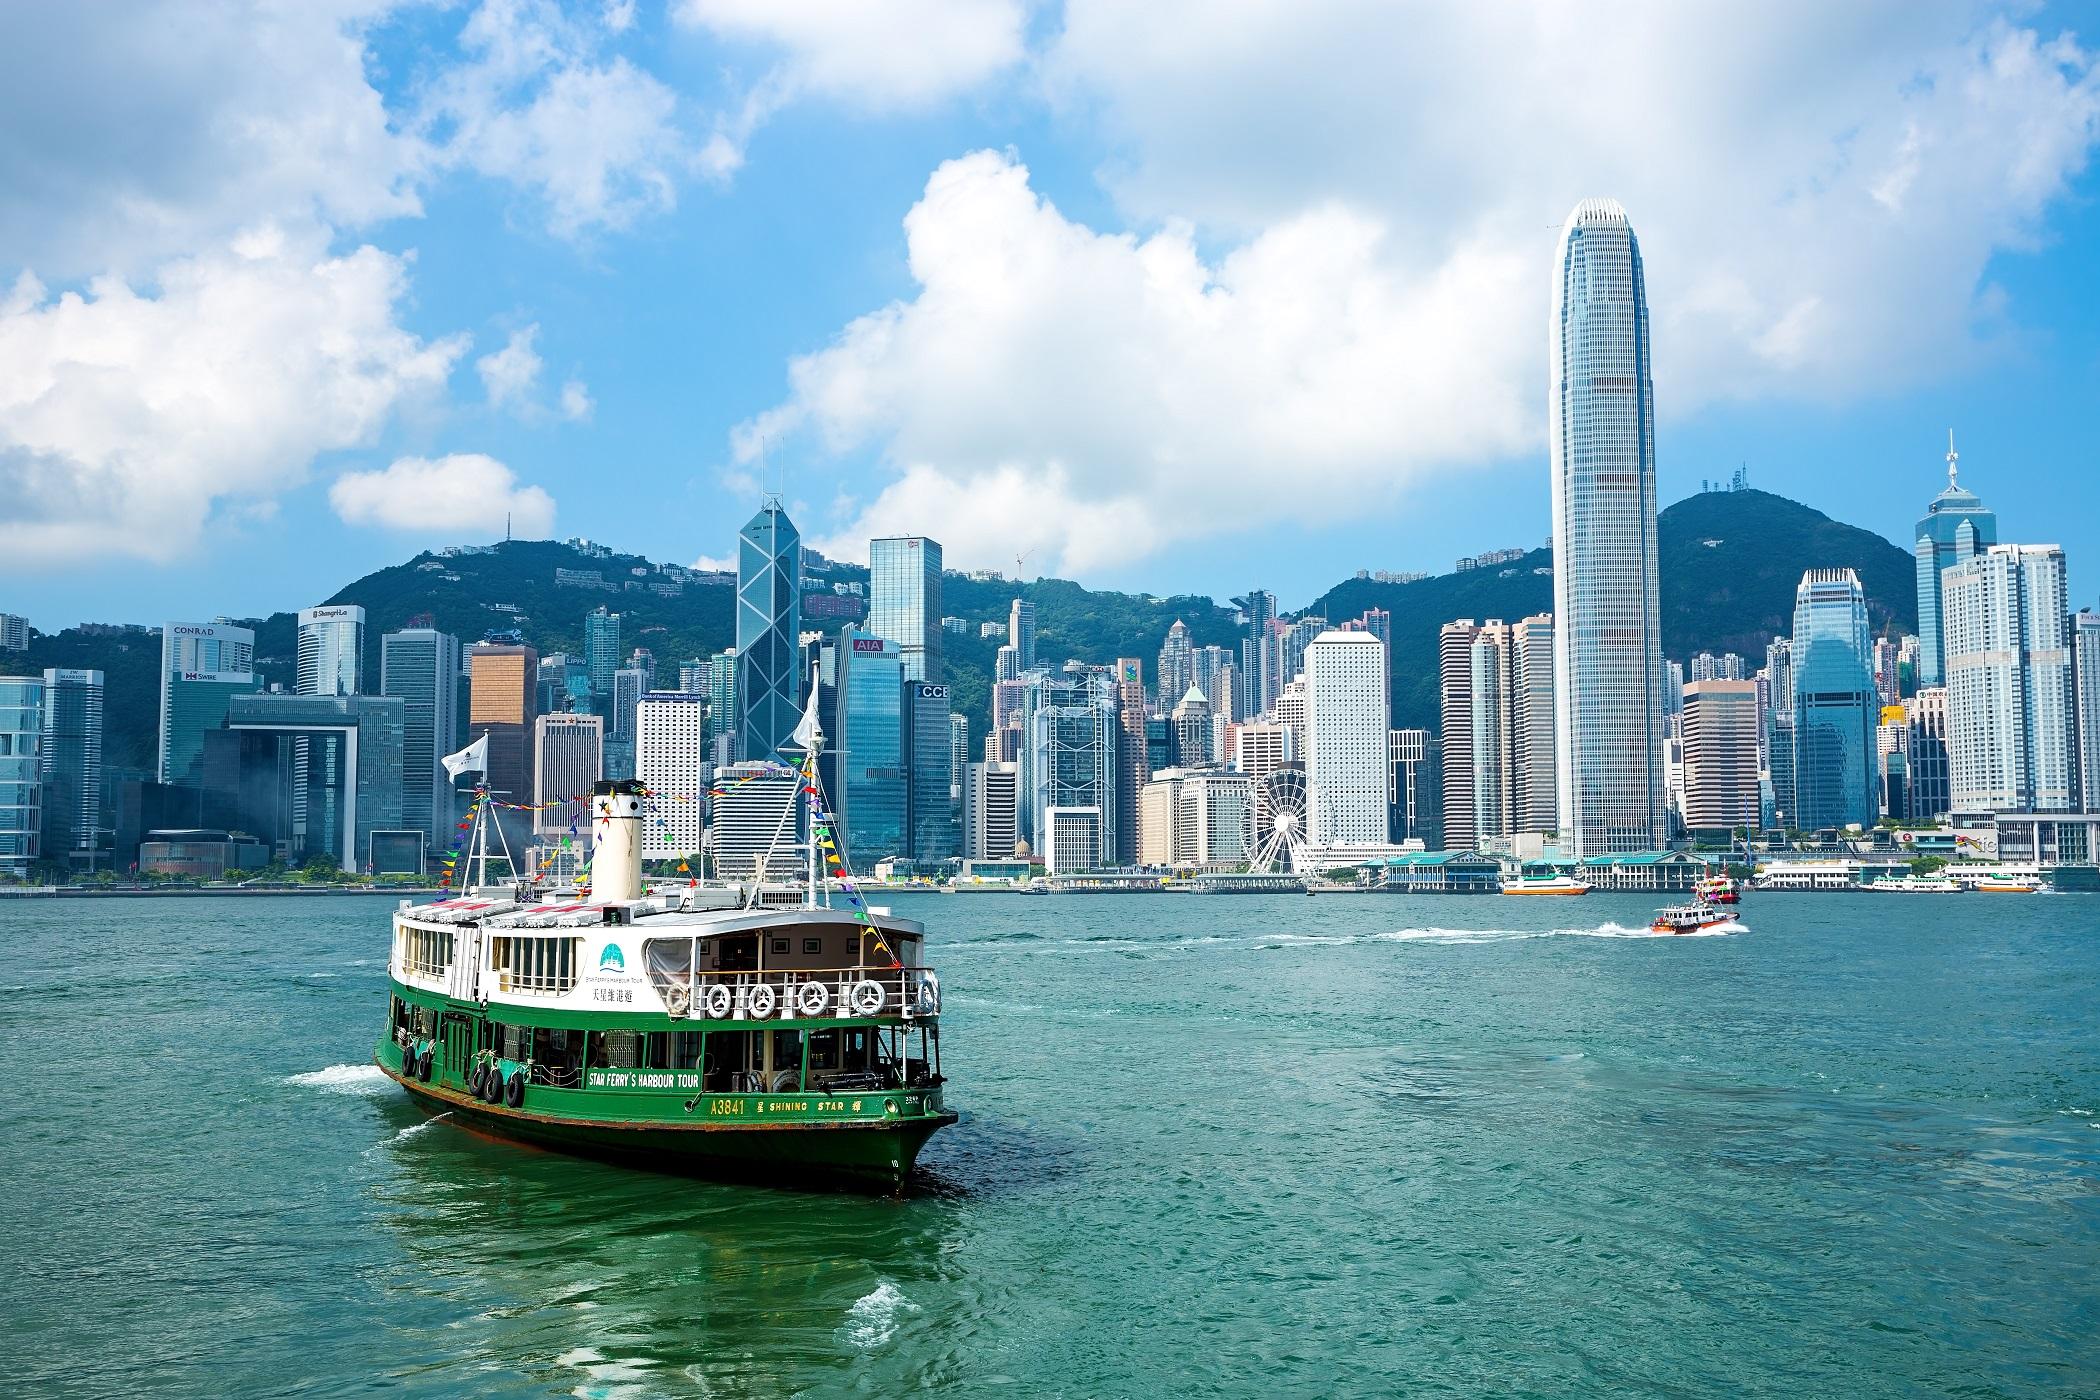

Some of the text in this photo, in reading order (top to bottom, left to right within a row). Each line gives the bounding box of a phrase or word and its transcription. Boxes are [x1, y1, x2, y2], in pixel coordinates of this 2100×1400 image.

[174, 627, 214, 635] CONRAD
[857, 641, 880, 650] AIA
[589, 1072, 699, 1088] STAR FERRY'S HARBOUR TOUR
[710, 1099, 744, 1115] A3841
[769, 1102, 808, 1111] SHINING
[818, 1101, 844, 1111] STAR
